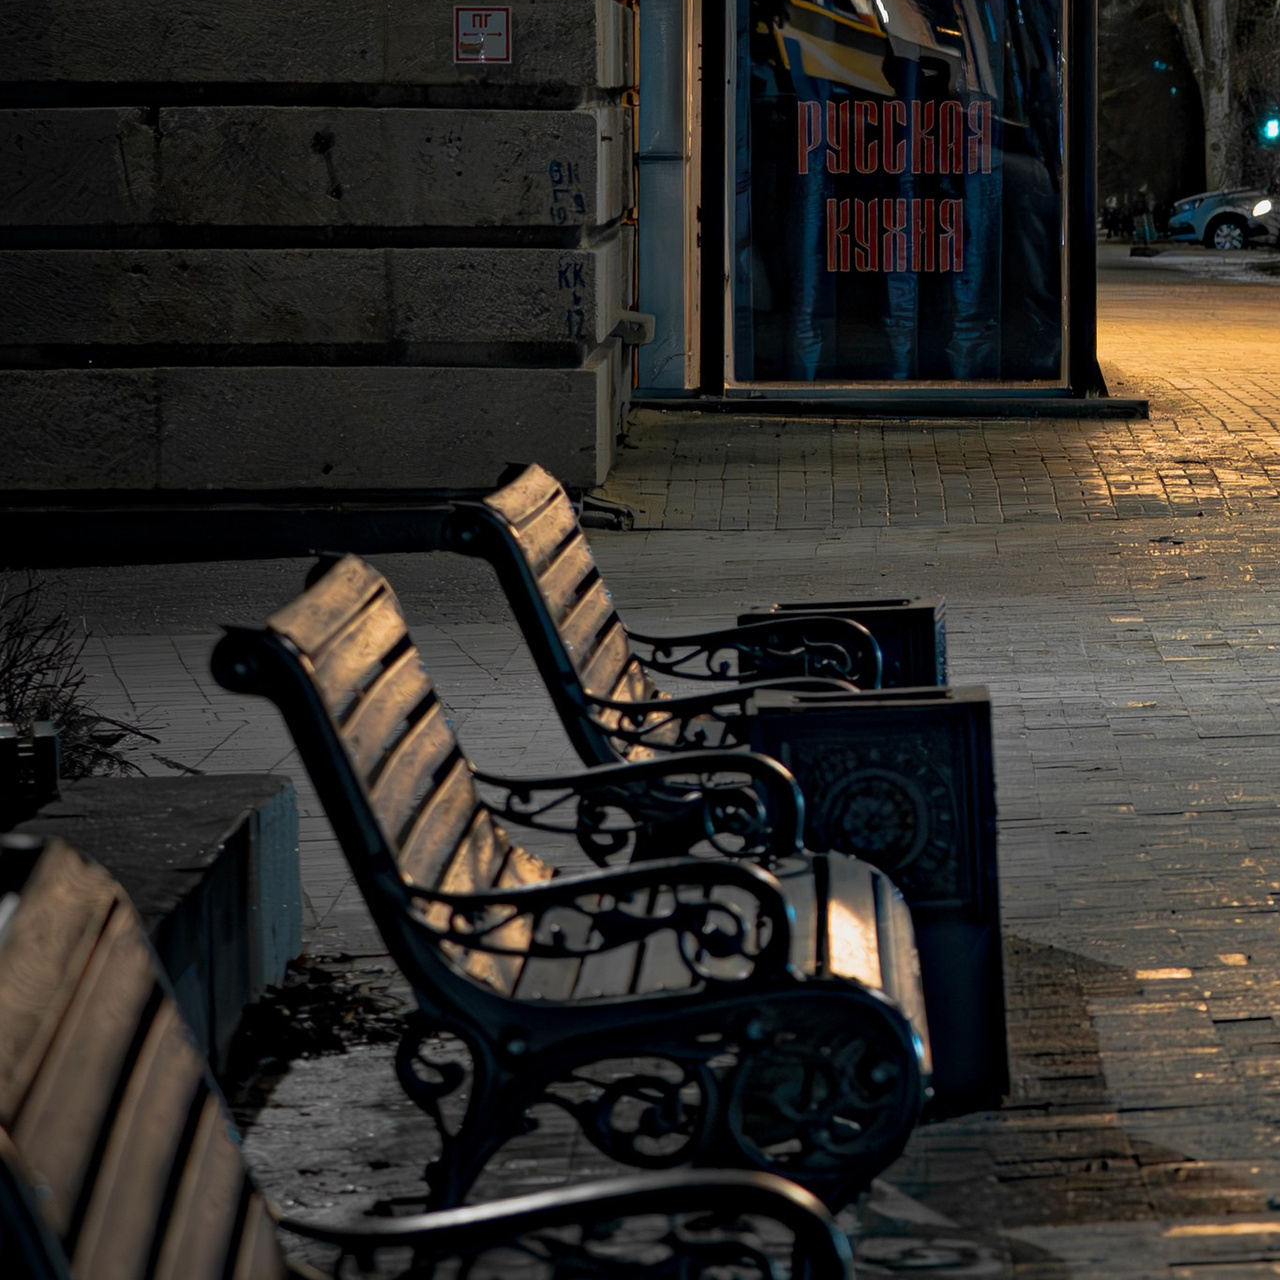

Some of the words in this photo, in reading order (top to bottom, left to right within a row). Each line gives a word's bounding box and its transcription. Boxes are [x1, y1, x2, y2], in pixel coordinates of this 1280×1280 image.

[472, 14, 492, 28] ПГ
[797, 99, 992, 175] РУССКАЯ
[826, 197, 964, 274] КУХНЯ
